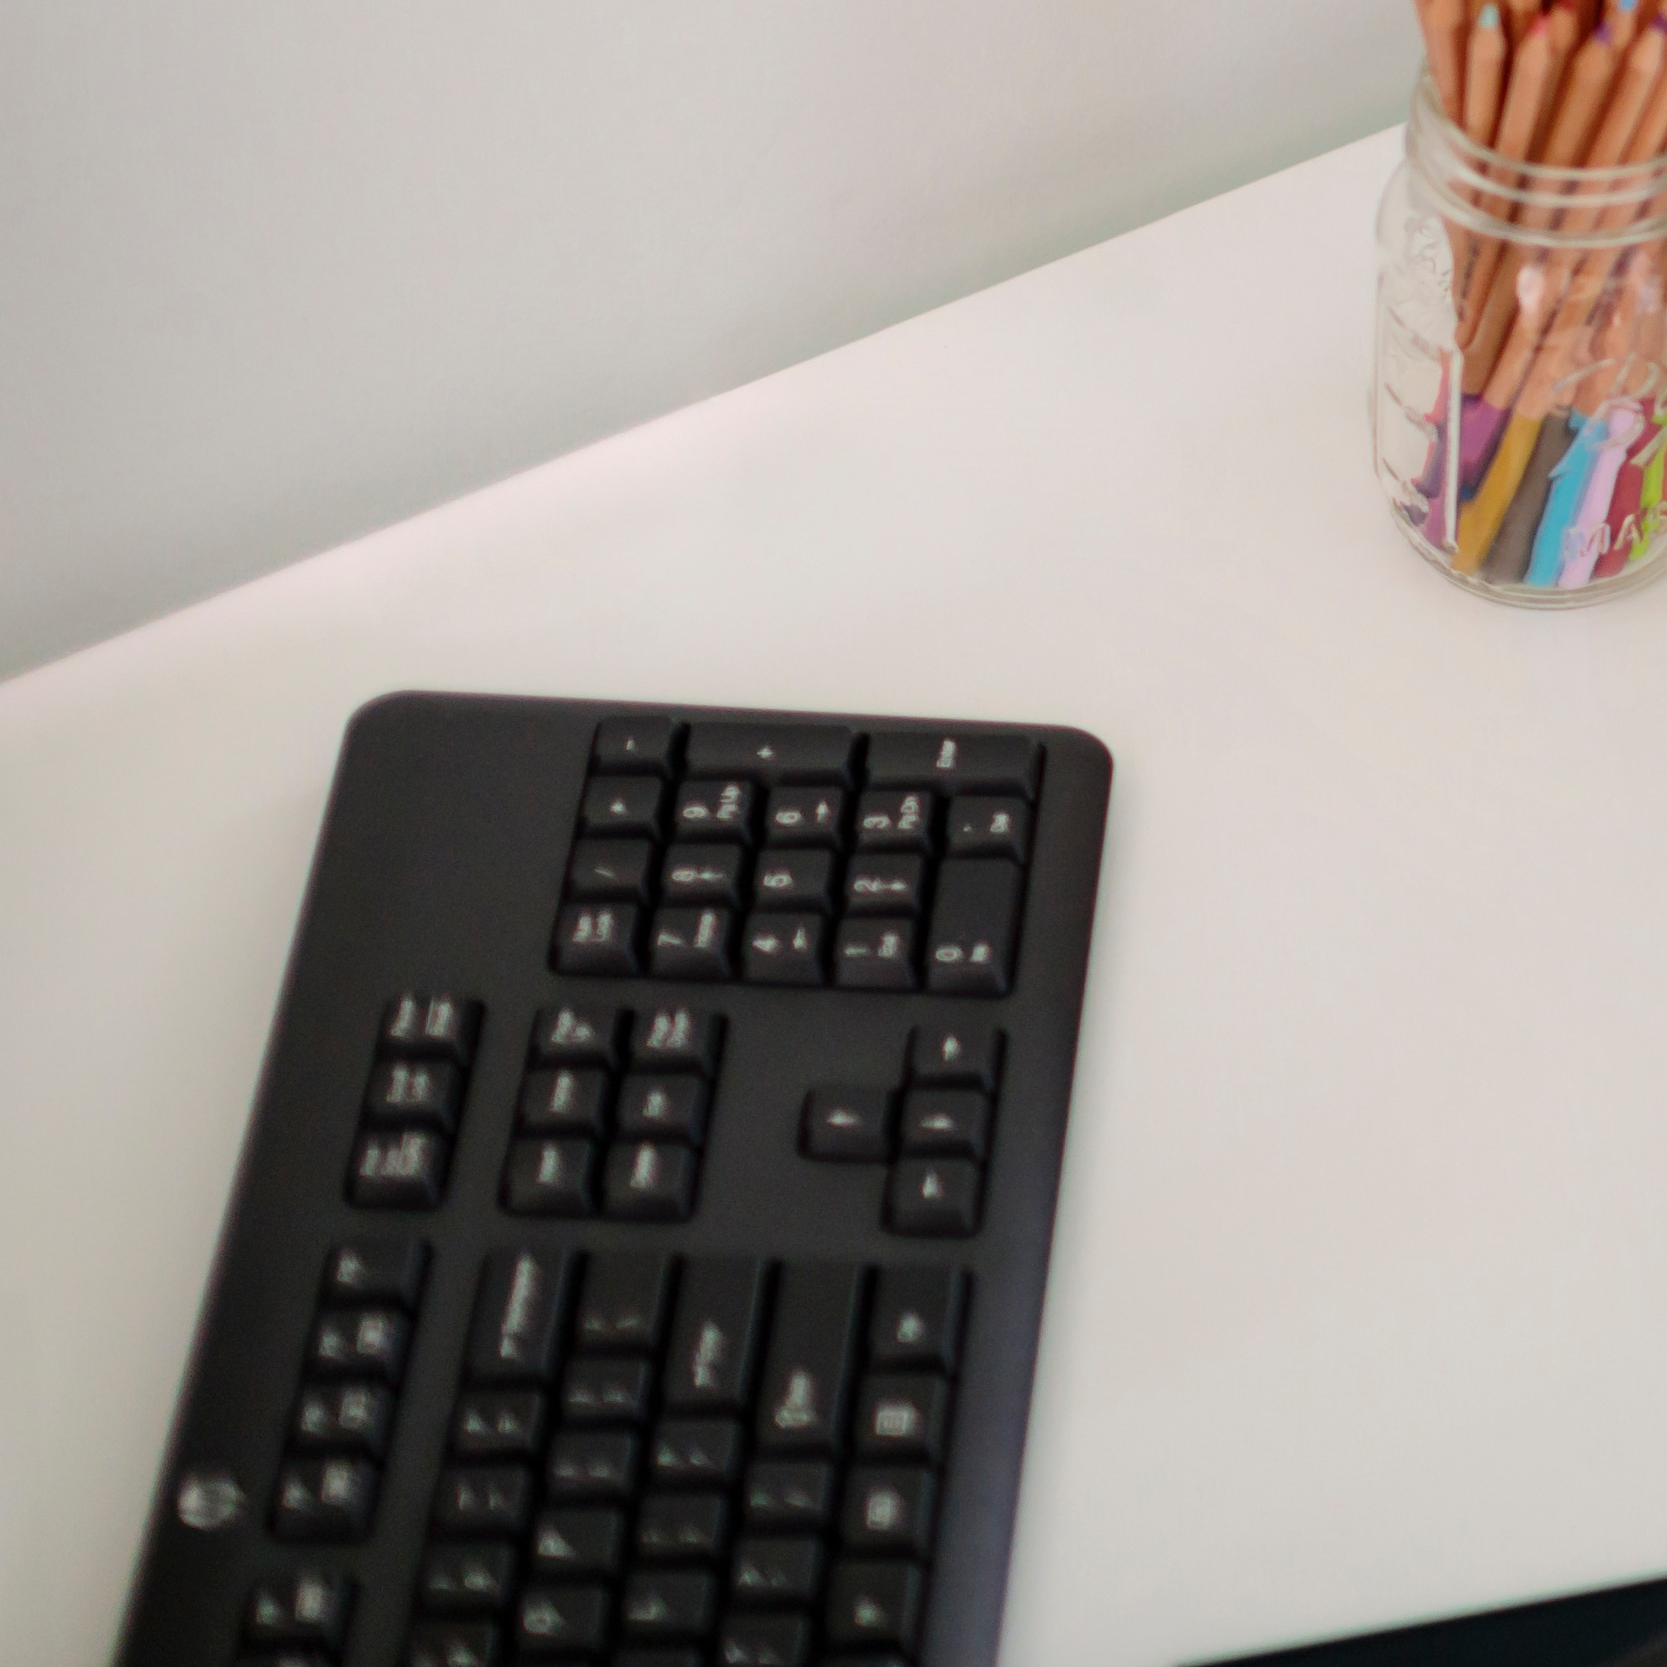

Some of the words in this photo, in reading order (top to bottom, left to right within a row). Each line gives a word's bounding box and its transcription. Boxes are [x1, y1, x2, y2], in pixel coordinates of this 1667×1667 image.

[682, 806, 709, 820] 9
[775, 810, 801, 825] 6
[863, 815, 890, 829] 3
[763, 873, 792, 888] 5
[854, 879, 881, 892] 2
[657, 931, 684, 946] 7
[753, 936, 779, 952] 4
